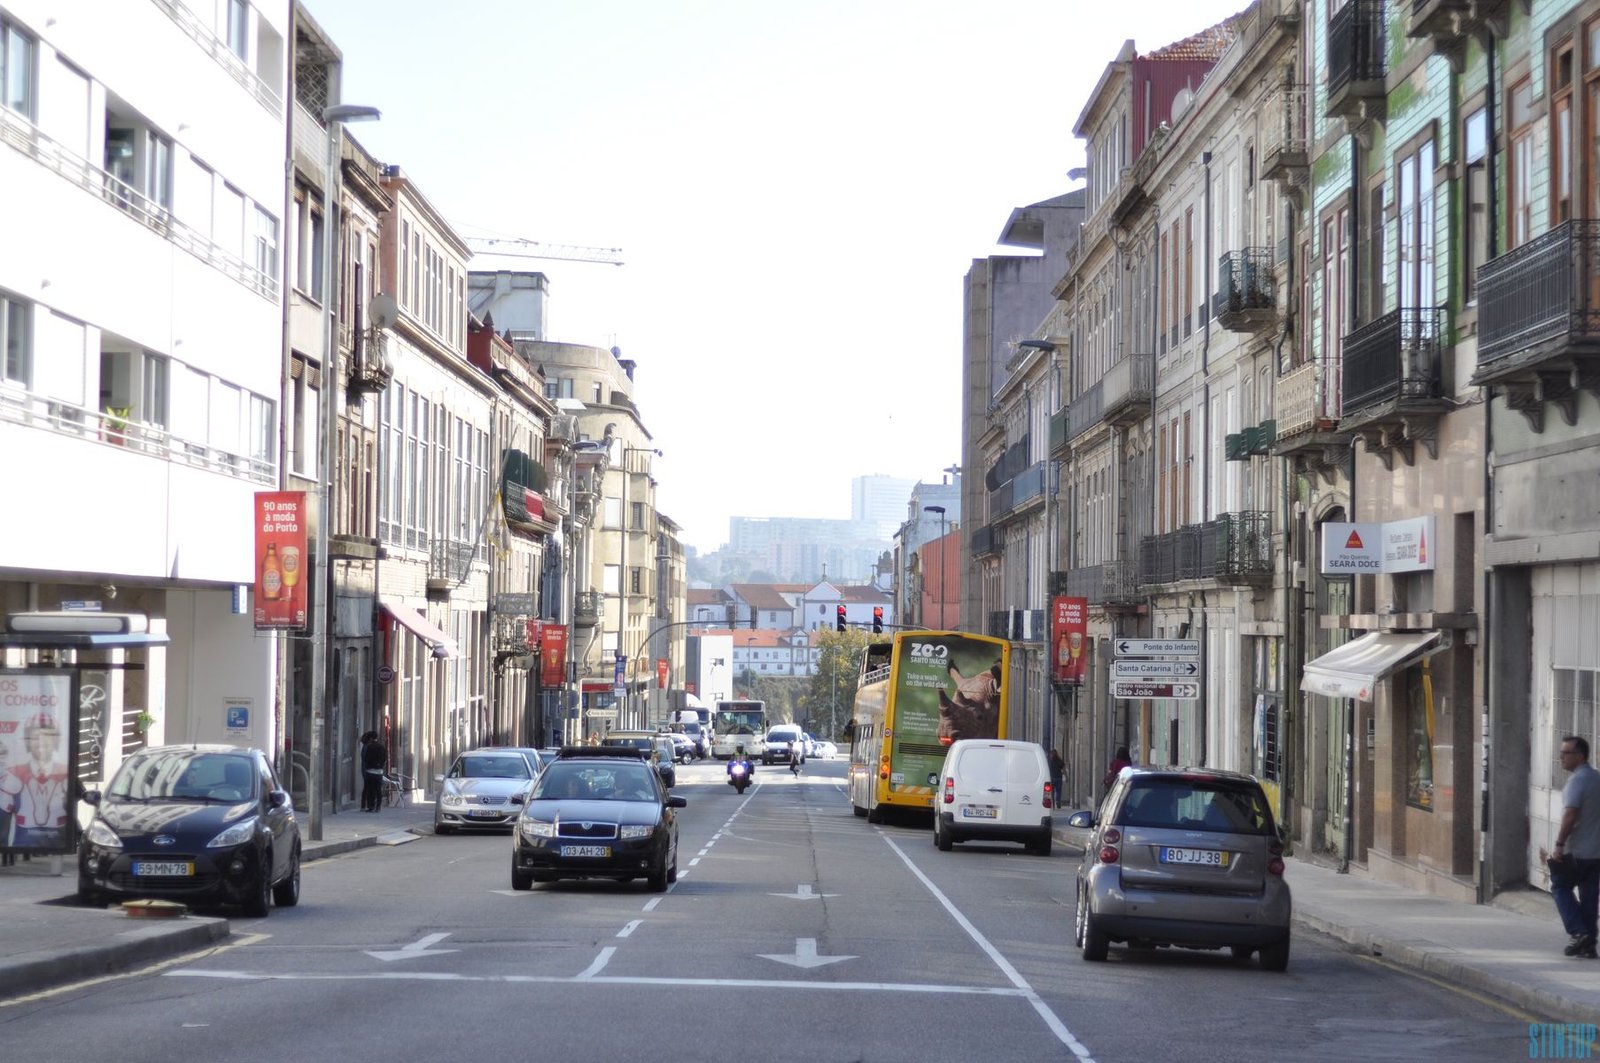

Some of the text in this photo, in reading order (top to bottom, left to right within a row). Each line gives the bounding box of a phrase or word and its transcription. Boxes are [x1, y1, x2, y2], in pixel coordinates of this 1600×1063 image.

[263, 501, 297, 511] 90 anos
[272, 511, 296, 522] moda
[263, 522, 298, 533] do Porto
[1329, 560, 1380, 568] SEARA DOCE
[1143, 643, 1198, 651] Ponte do Infante
[1117, 664, 1171, 672] Santa Catarina
[906, 672, 920, 680] Take
[1117, 688, 1153, 696] São João
[4, 694, 60, 707] COMIGO
